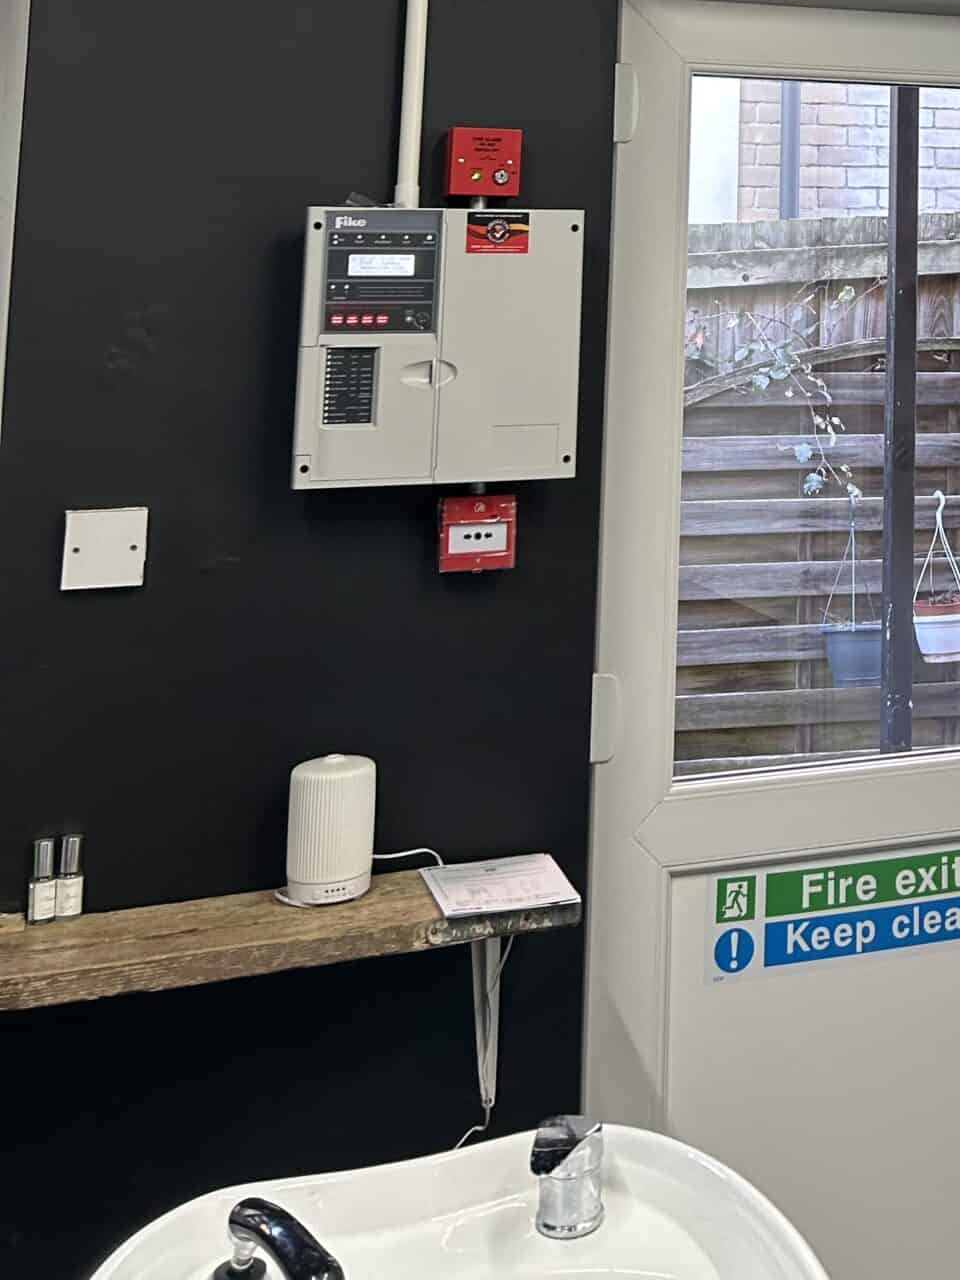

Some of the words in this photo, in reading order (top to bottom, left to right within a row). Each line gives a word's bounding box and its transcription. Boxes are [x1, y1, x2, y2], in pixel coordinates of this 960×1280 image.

[335, 216, 367, 229] Fike
[801, 871, 877, 909] Fire
[786, 919, 876, 954] Keep
